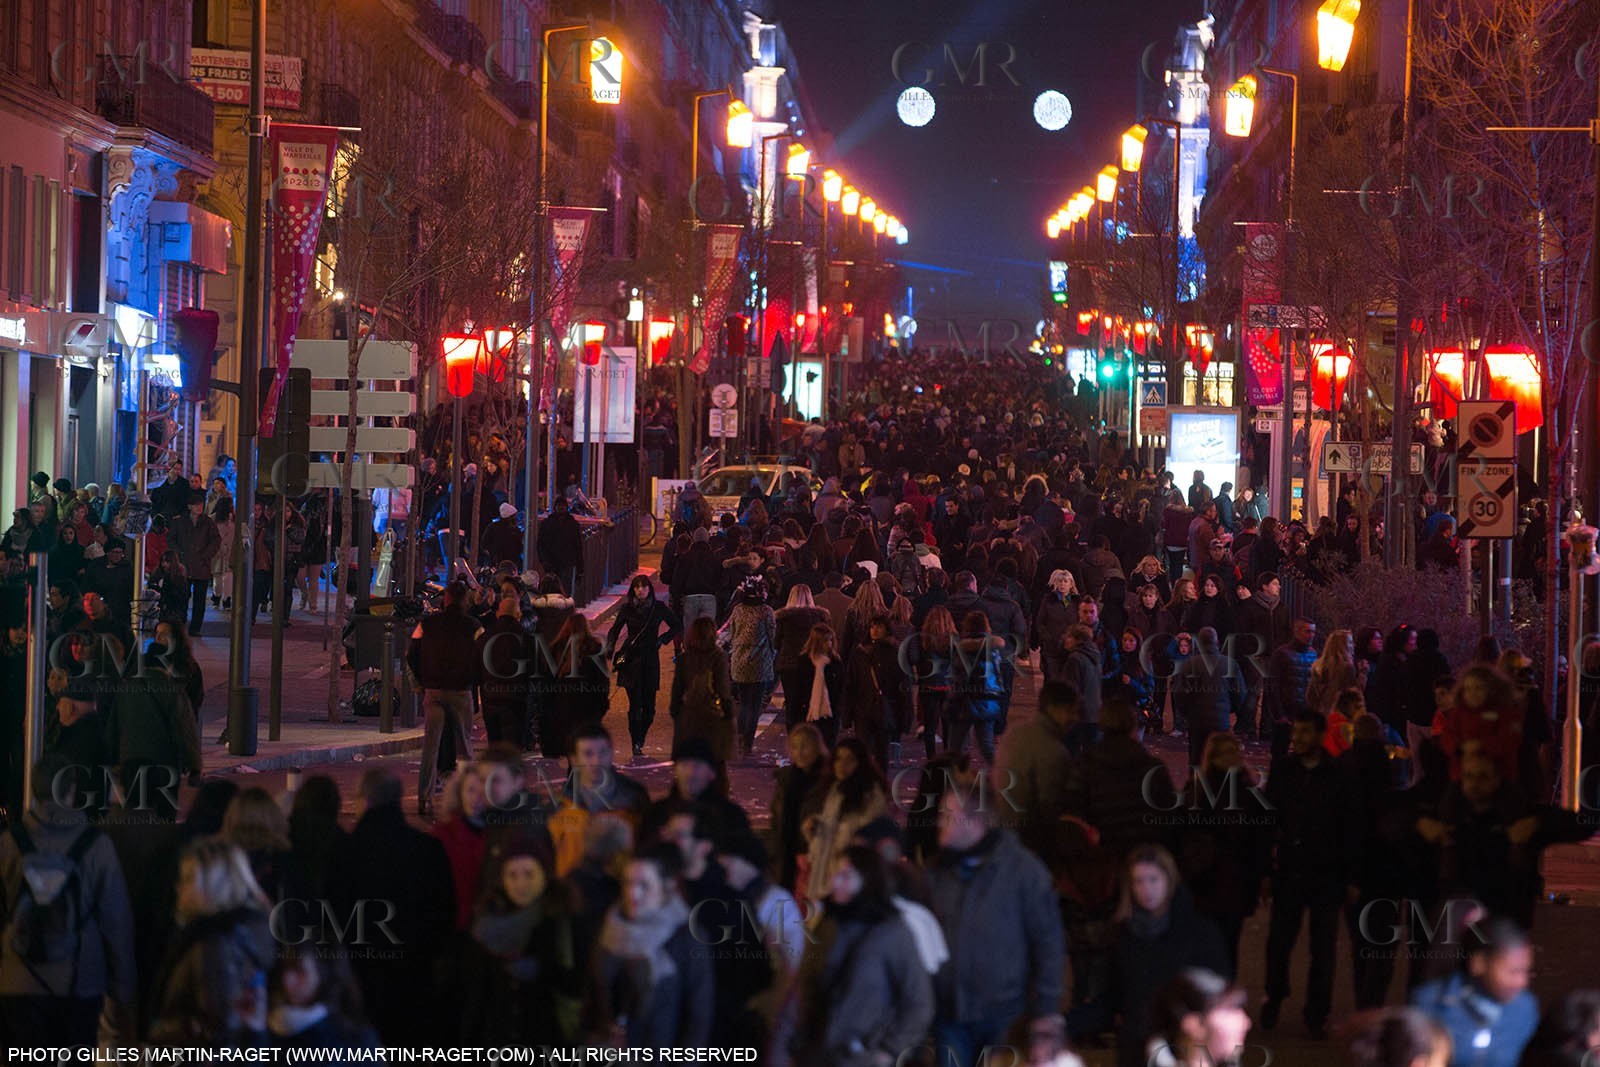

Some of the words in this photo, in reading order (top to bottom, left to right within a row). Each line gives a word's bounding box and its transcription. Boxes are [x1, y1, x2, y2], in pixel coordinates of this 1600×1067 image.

[208, 69, 238, 79] FRAIS
[217, 88, 243, 100] 500
[283, 152, 322, 160] MARSEILLE
[1461, 466, 1477, 475] FIN
[1486, 466, 1510, 476] ZONE
[1475, 501, 1497, 517] 30
